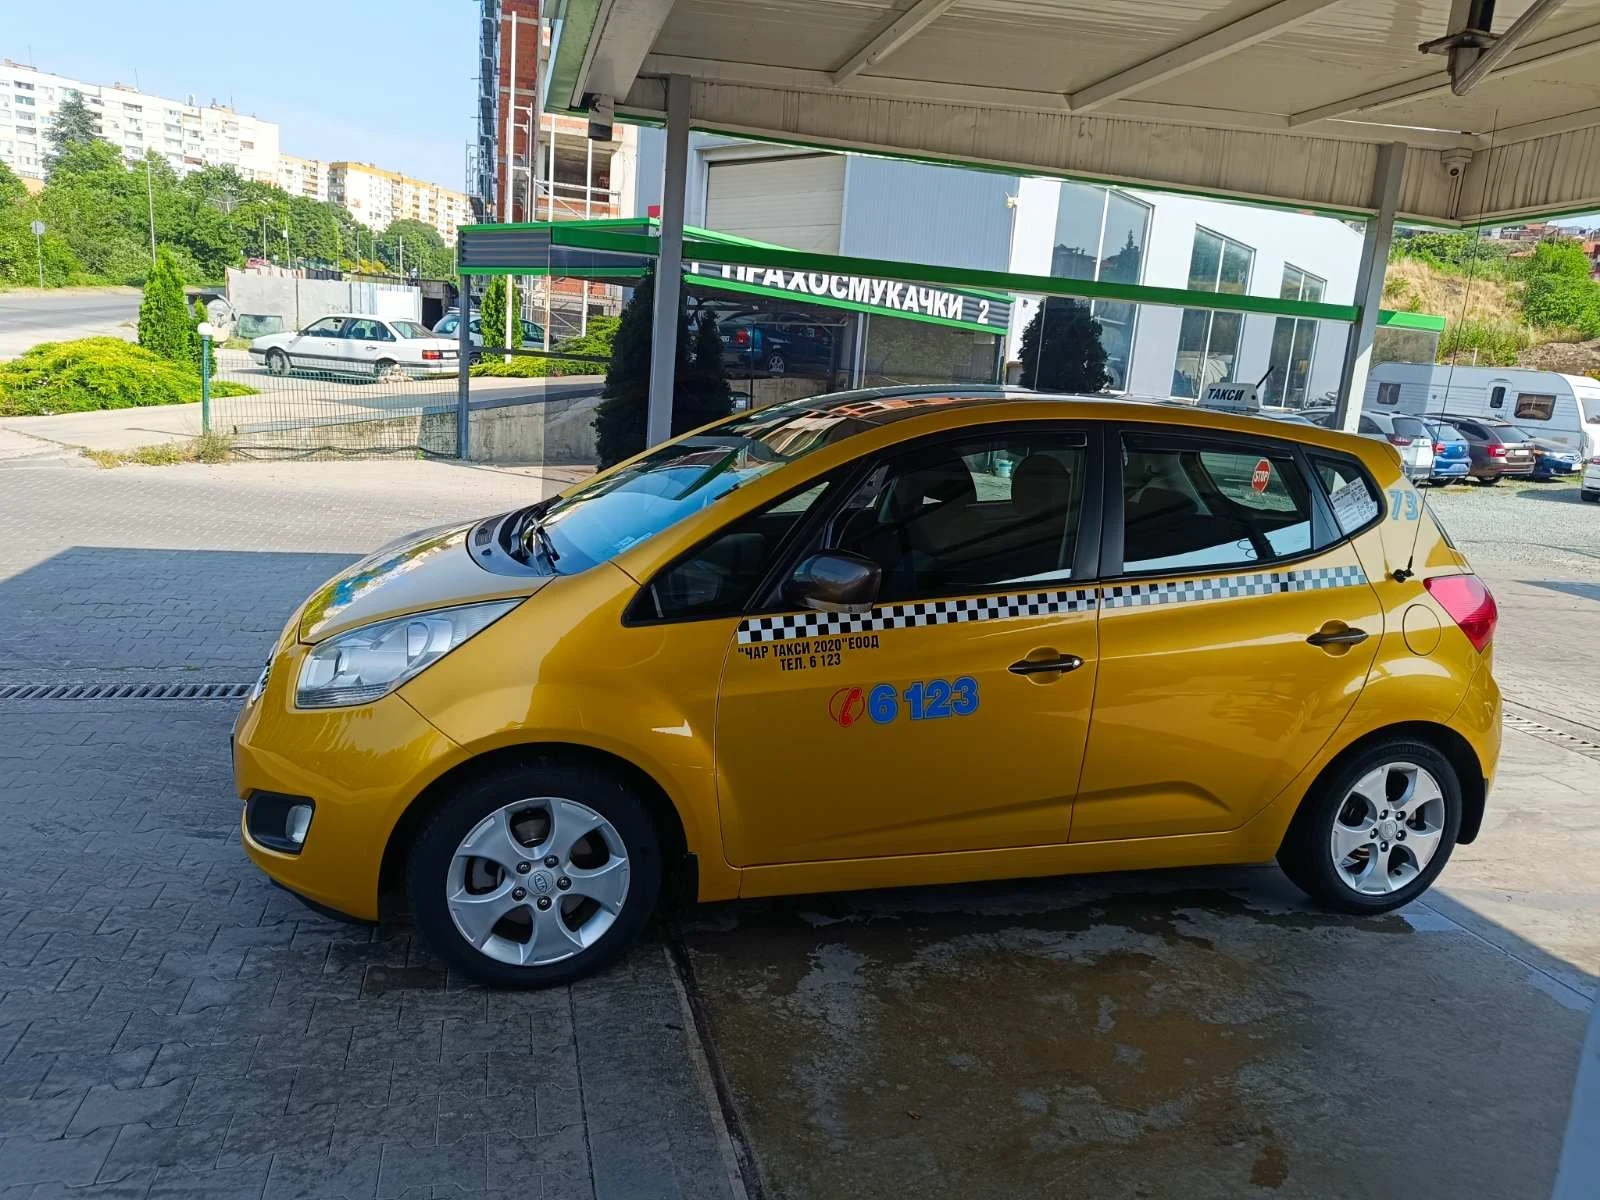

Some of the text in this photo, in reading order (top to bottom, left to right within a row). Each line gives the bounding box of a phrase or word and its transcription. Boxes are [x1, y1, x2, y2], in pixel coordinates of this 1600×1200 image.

[977, 299, 990, 324] 2
[1207, 388, 1246, 401] ТАКСИ
[1253, 470, 1270, 483] STOP
[1389, 490, 1419, 521] 73
[737, 645, 769, 660] "ЧАР
[772, 641, 811, 657] ТАКСИ
[780, 652, 841, 671] ТЕЛ. 6 123
[868, 675, 980, 725] 6 123
